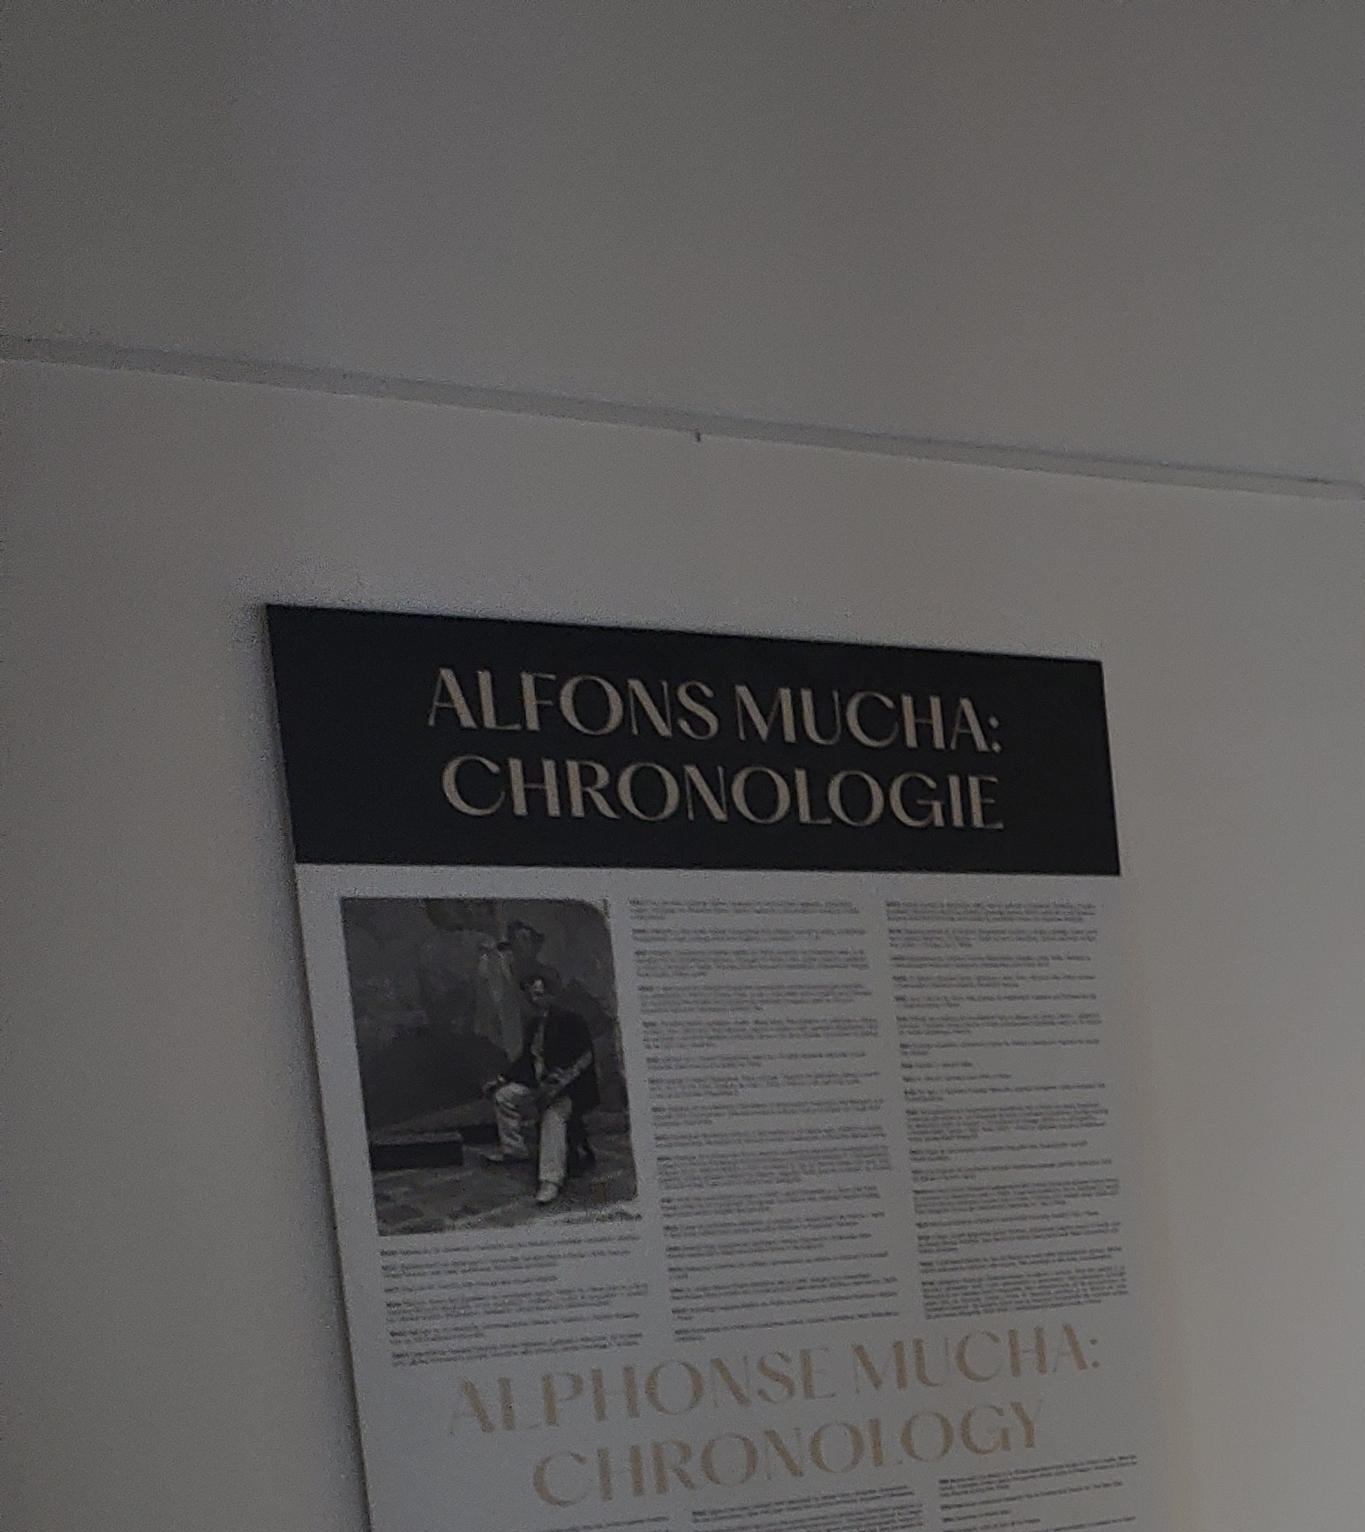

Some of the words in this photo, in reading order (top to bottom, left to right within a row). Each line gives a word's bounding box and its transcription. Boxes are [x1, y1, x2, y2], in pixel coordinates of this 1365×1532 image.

[428, 666, 720, 739] ALFONS
[735, 684, 1003, 753] MUCHA:
[442, 754, 1005, 830] CHRONOLOGIE
[449, 1346, 836, 1433] ALPHONSE
[852, 1323, 1100, 1391] MUCHA:
[532, 1398, 1044, 1506] CHRONOLOGY
